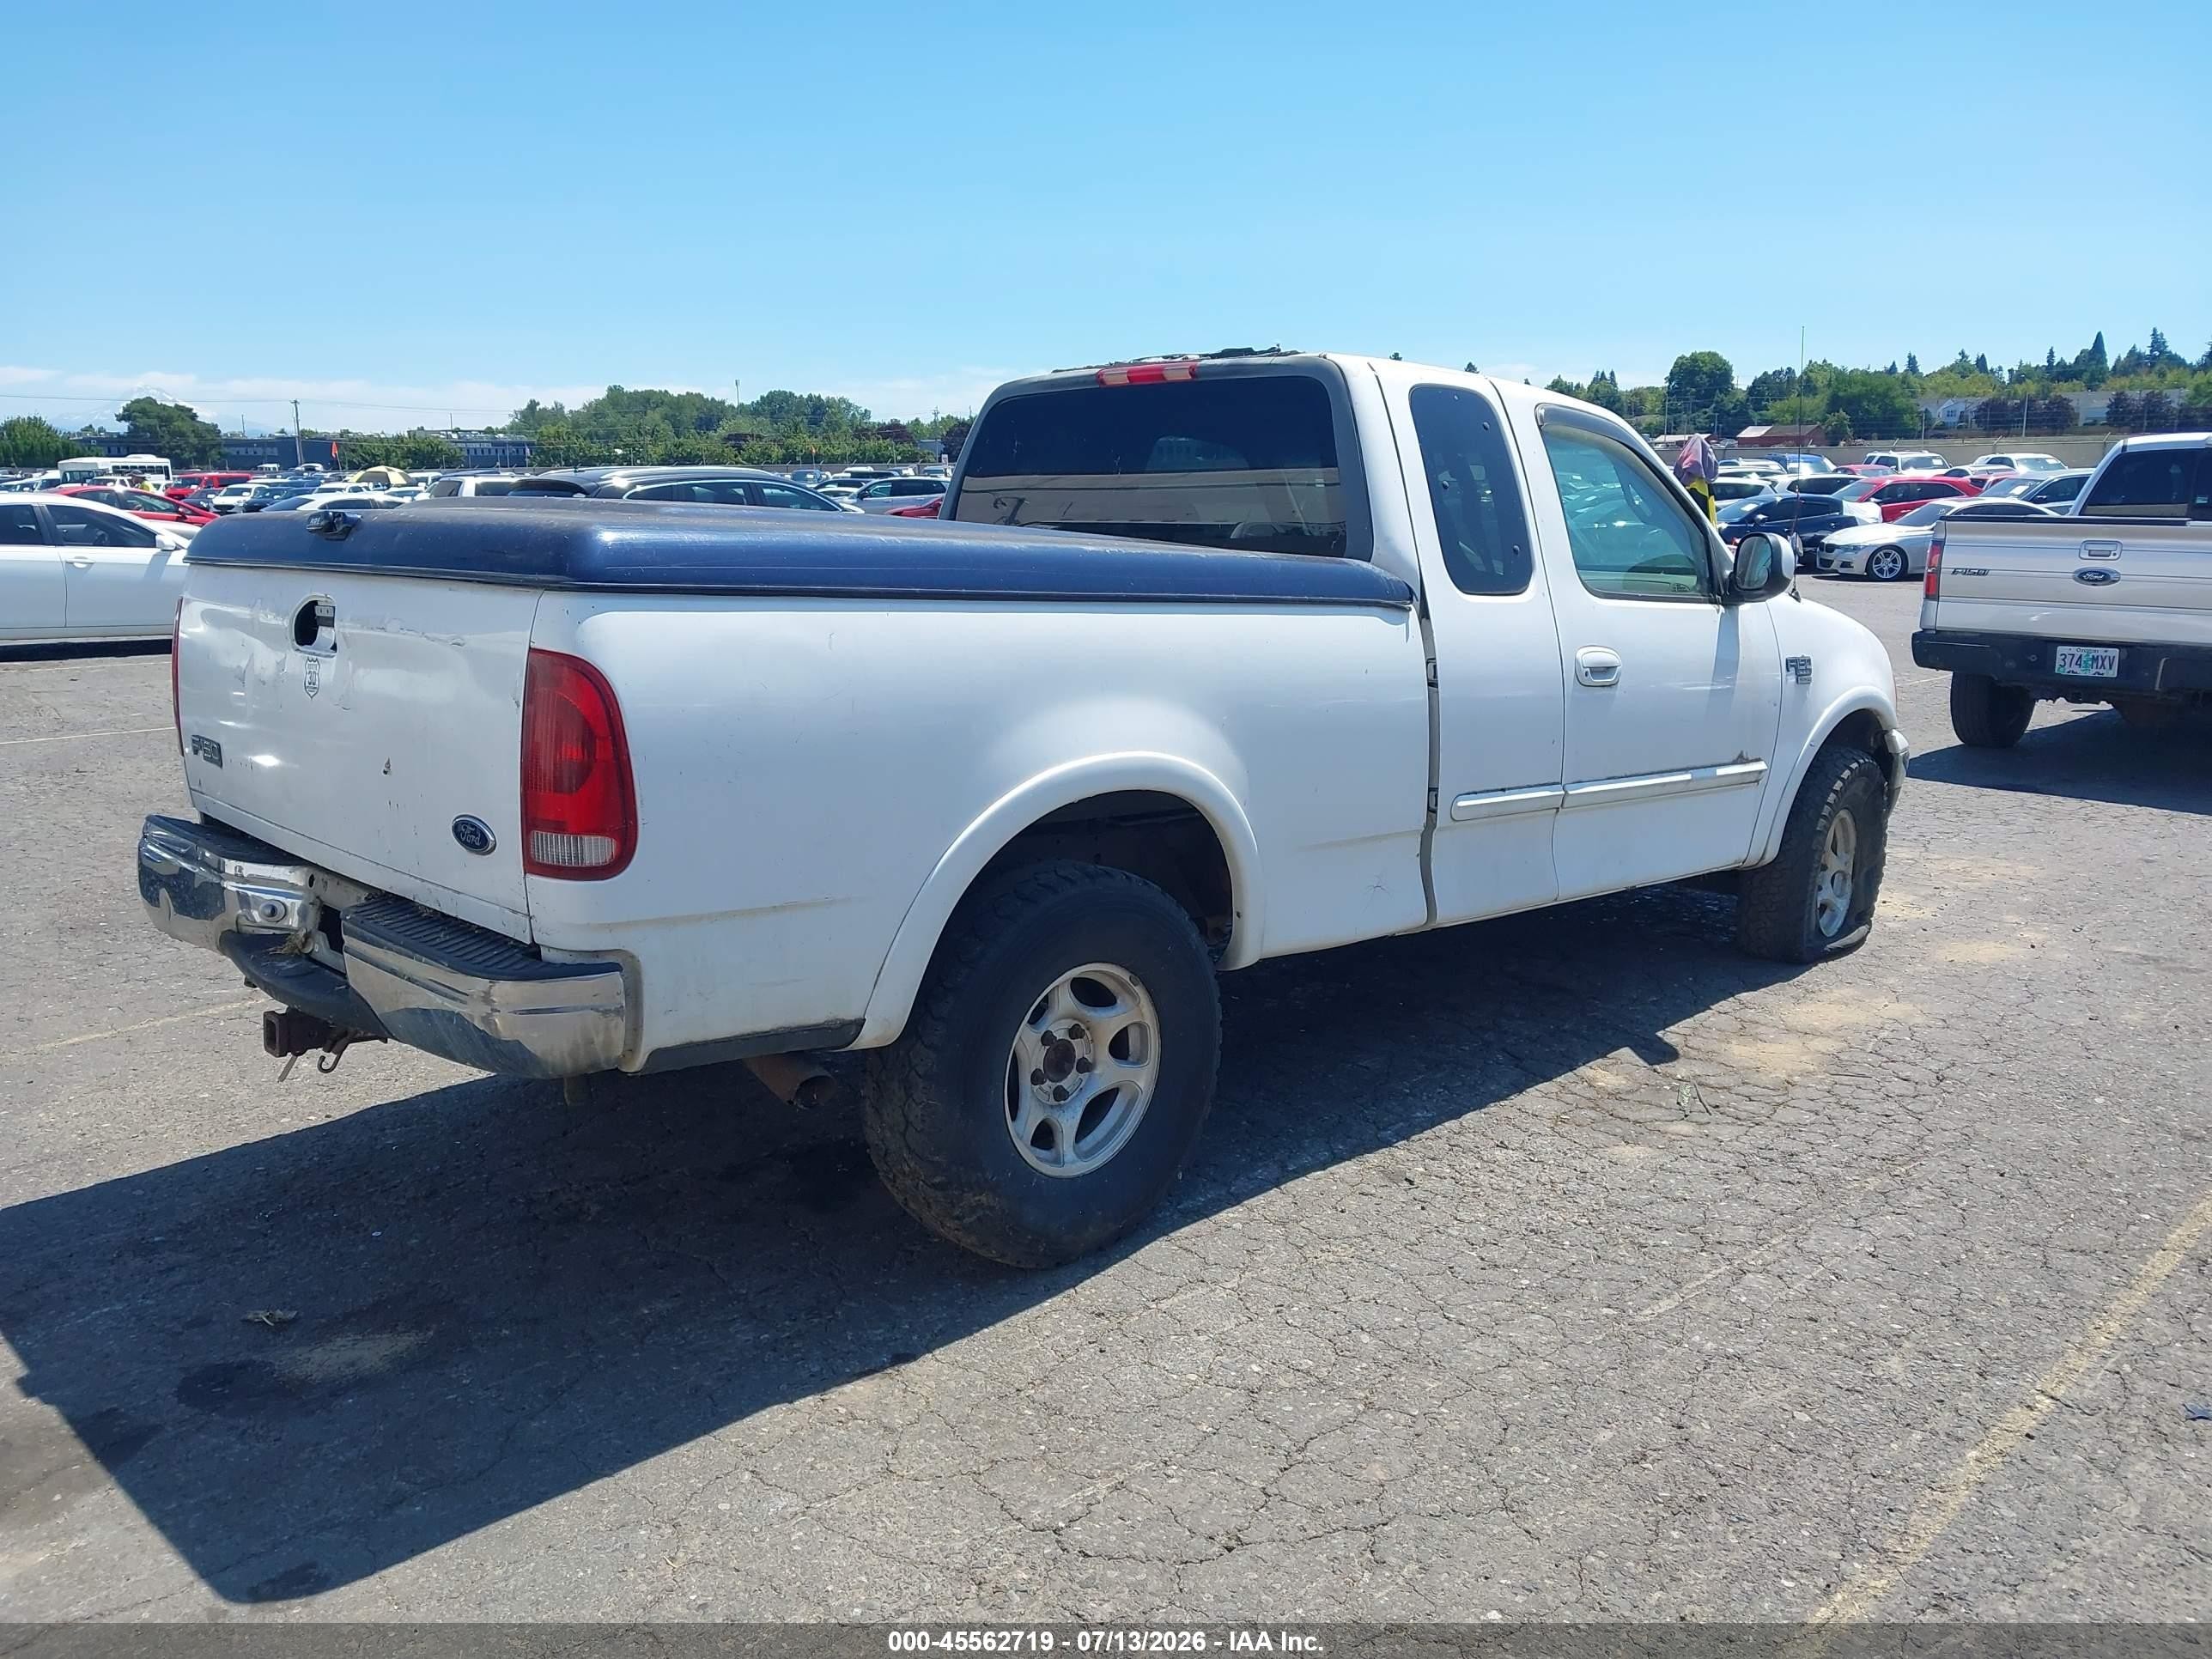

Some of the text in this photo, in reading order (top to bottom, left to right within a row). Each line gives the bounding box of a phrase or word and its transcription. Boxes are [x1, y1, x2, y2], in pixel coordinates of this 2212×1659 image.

[2058, 653, 2116, 670] 374 MXV
[307, 671, 318, 686] 30
[459, 823, 482, 846] Ford
